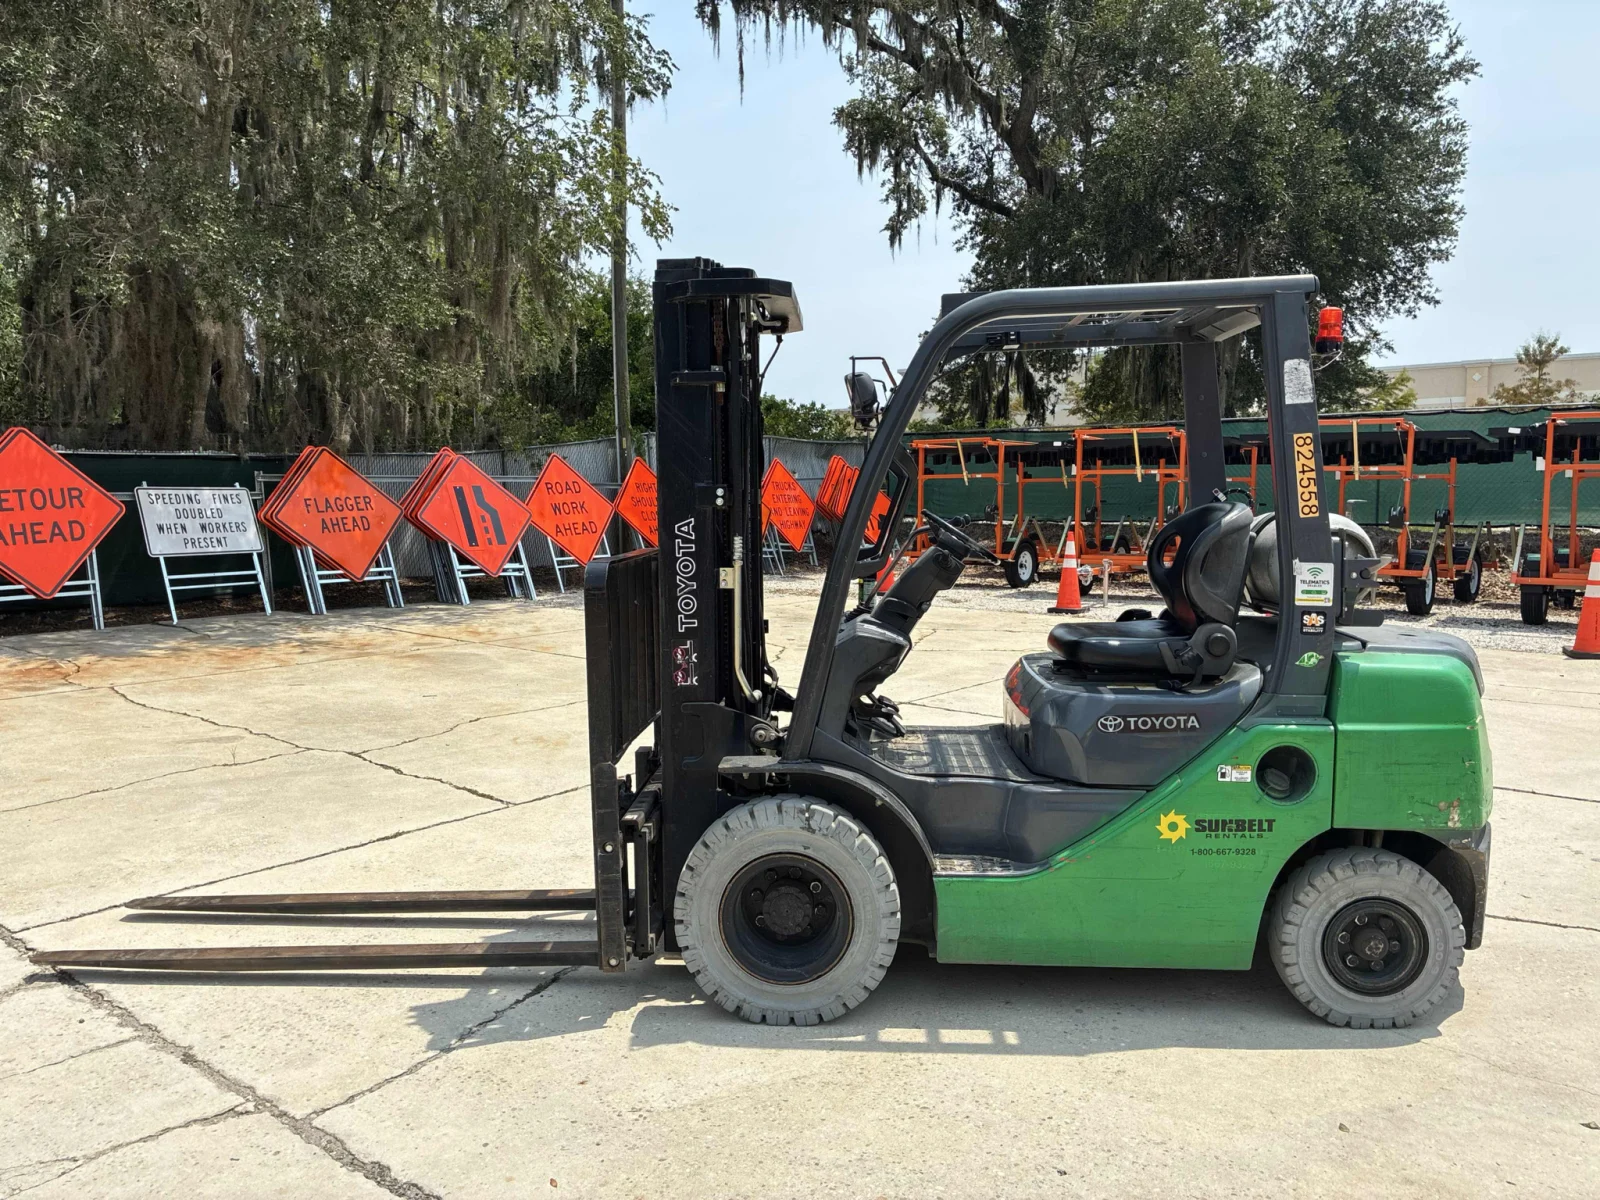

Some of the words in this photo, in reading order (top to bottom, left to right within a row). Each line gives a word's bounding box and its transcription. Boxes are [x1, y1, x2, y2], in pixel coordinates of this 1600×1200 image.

[1296, 436, 1318, 515] 824558
[545, 481, 581, 495] ROAD
[771, 481, 796, 490] TRUCKS
[0, 487, 85, 512] ETOUR
[148, 493, 201, 505] SPEEDING
[212, 493, 242, 504] FINES
[304, 496, 374, 514] FLAGGER
[631, 496, 658, 507] SHOUL
[772, 494, 802, 503] ENTERING
[175, 508, 223, 519] DOUBLED
[551, 501, 589, 516] WORK
[785, 507, 809, 516] LEAVING
[157, 523, 188, 534] WHEN
[199, 521, 248, 534] WORKERS
[321, 516, 370, 534] AHEAD
[555, 521, 598, 537] AHEAD
[780, 520, 805, 529] HIGHWAY
[183, 537, 228, 549] PRESENT
[675, 518, 698, 633] TOYOTA
[1303, 613, 1324, 626] SAS
[1127, 716, 1200, 730] TOYOTA
[1194, 819, 1276, 833] SUNBELT
[1190, 848, 1257, 856] 1-800-667-9328
